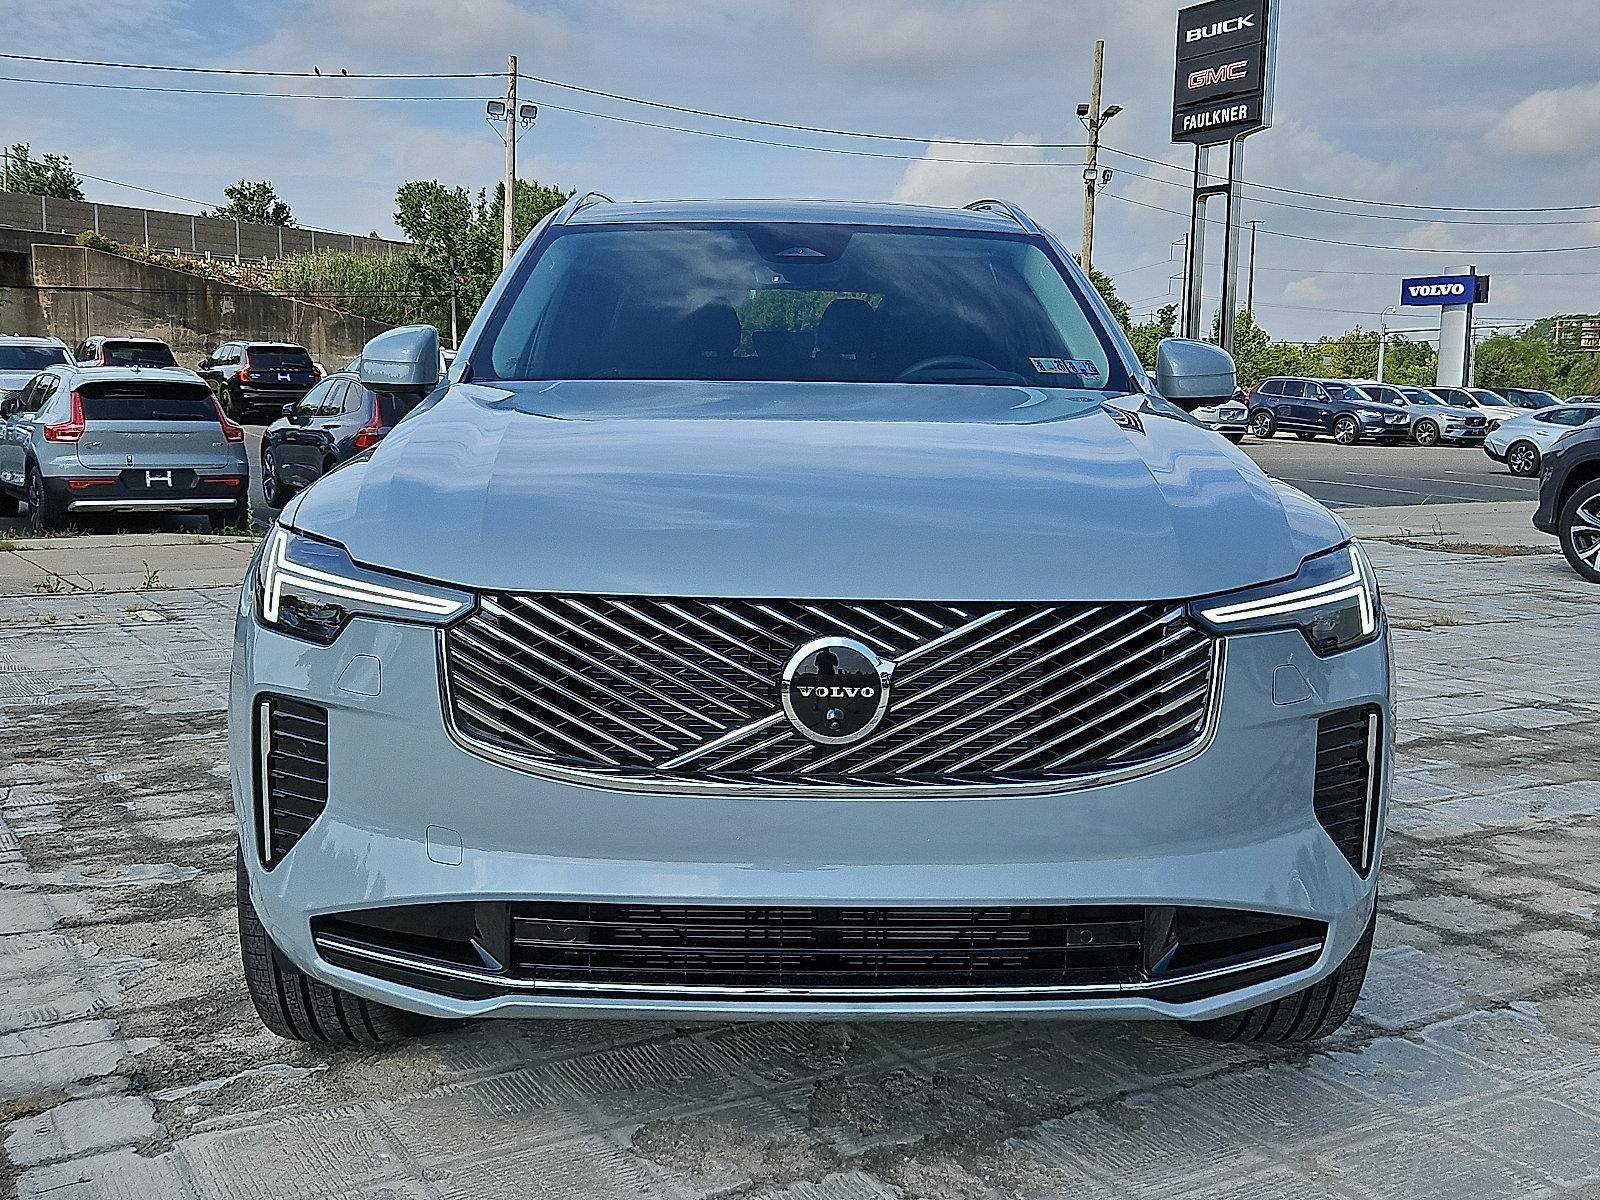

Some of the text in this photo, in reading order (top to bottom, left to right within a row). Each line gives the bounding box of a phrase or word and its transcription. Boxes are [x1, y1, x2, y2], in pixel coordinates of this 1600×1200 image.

[1185, 13, 1255, 43] BUICK
[1187, 60, 1248, 89] GMC
[1183, 104, 1248, 131] FAULKNER
[1408, 283, 1465, 297] VOLVO
[797, 686, 875, 698] VOLVO
